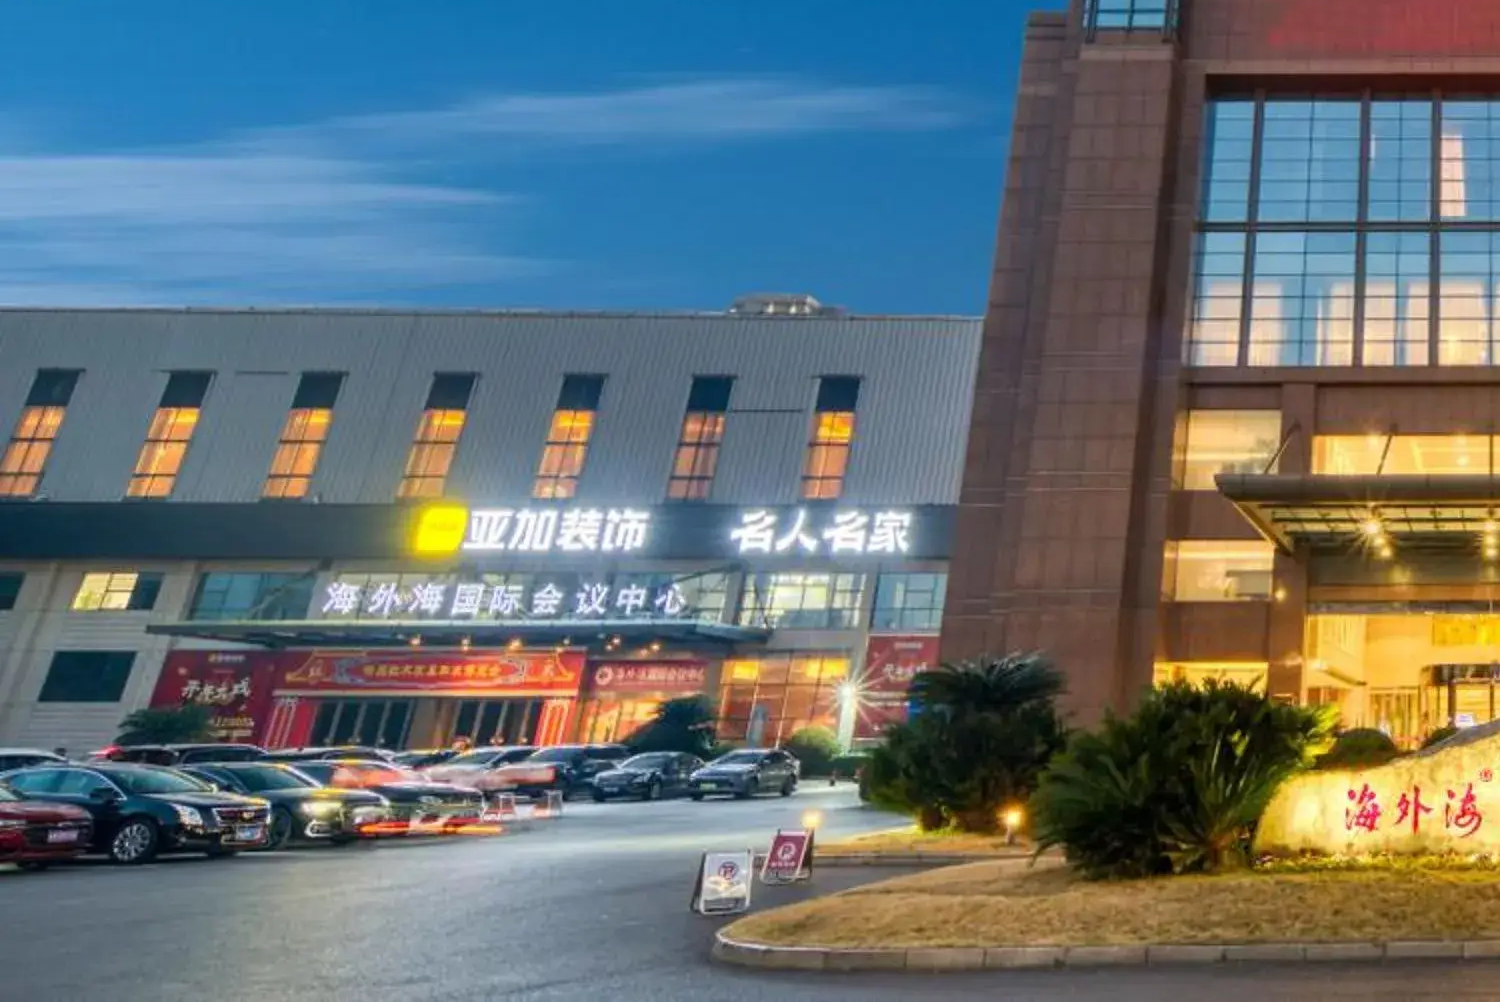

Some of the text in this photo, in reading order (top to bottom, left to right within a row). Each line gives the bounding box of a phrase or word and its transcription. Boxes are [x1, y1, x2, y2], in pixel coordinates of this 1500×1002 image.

[463, 507, 650, 551] 亚加装饰
[731, 508, 912, 553] 名人名家
[322, 582, 687, 616] 海外海国际会议中心
